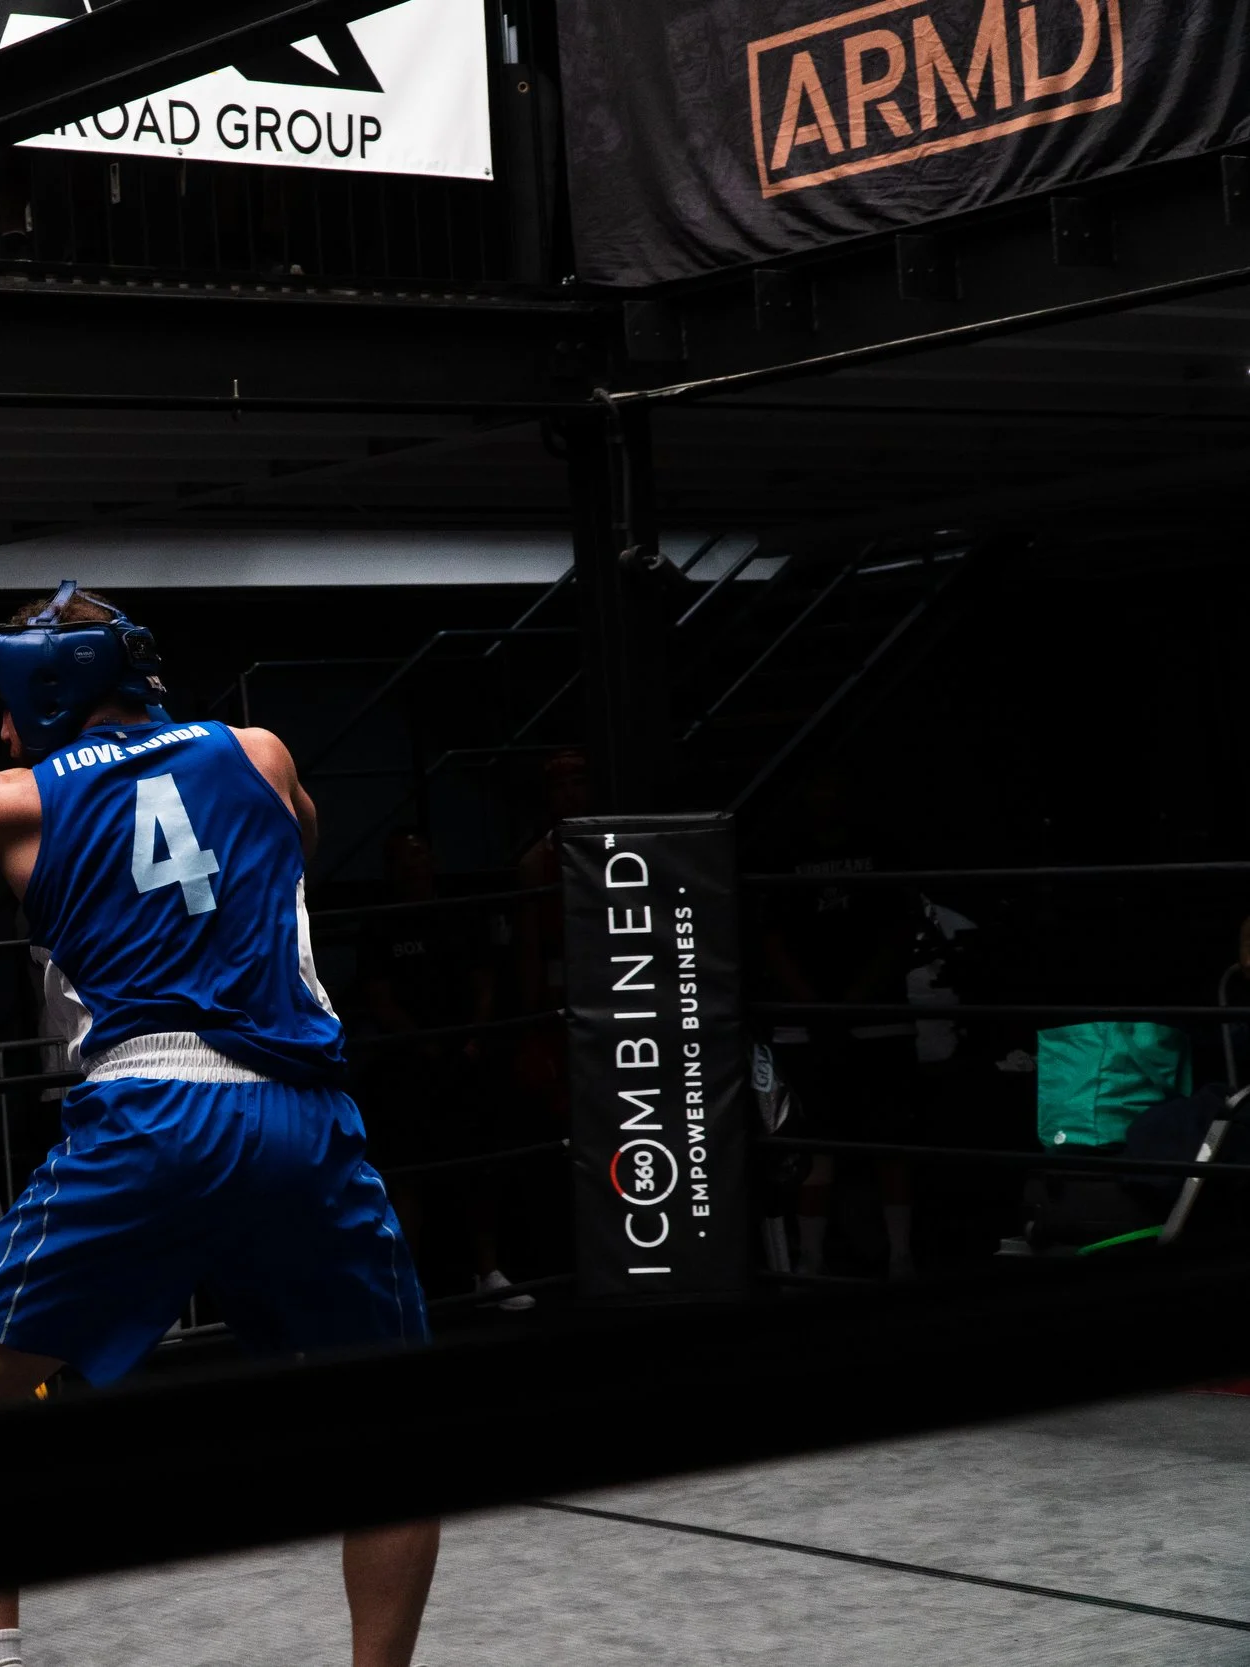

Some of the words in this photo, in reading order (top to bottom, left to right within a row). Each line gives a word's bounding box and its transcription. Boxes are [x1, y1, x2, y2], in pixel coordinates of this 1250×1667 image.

[216, 103, 382, 159] GROUP
[52, 758, 65, 777] I
[65, 744, 126, 771] LOVE
[131, 773, 220, 916] 4
[675, 907, 699, 1030] BUSINESS
[634, 1151, 655, 1192] 360
[683, 1043, 710, 1217] EMPOWERING
